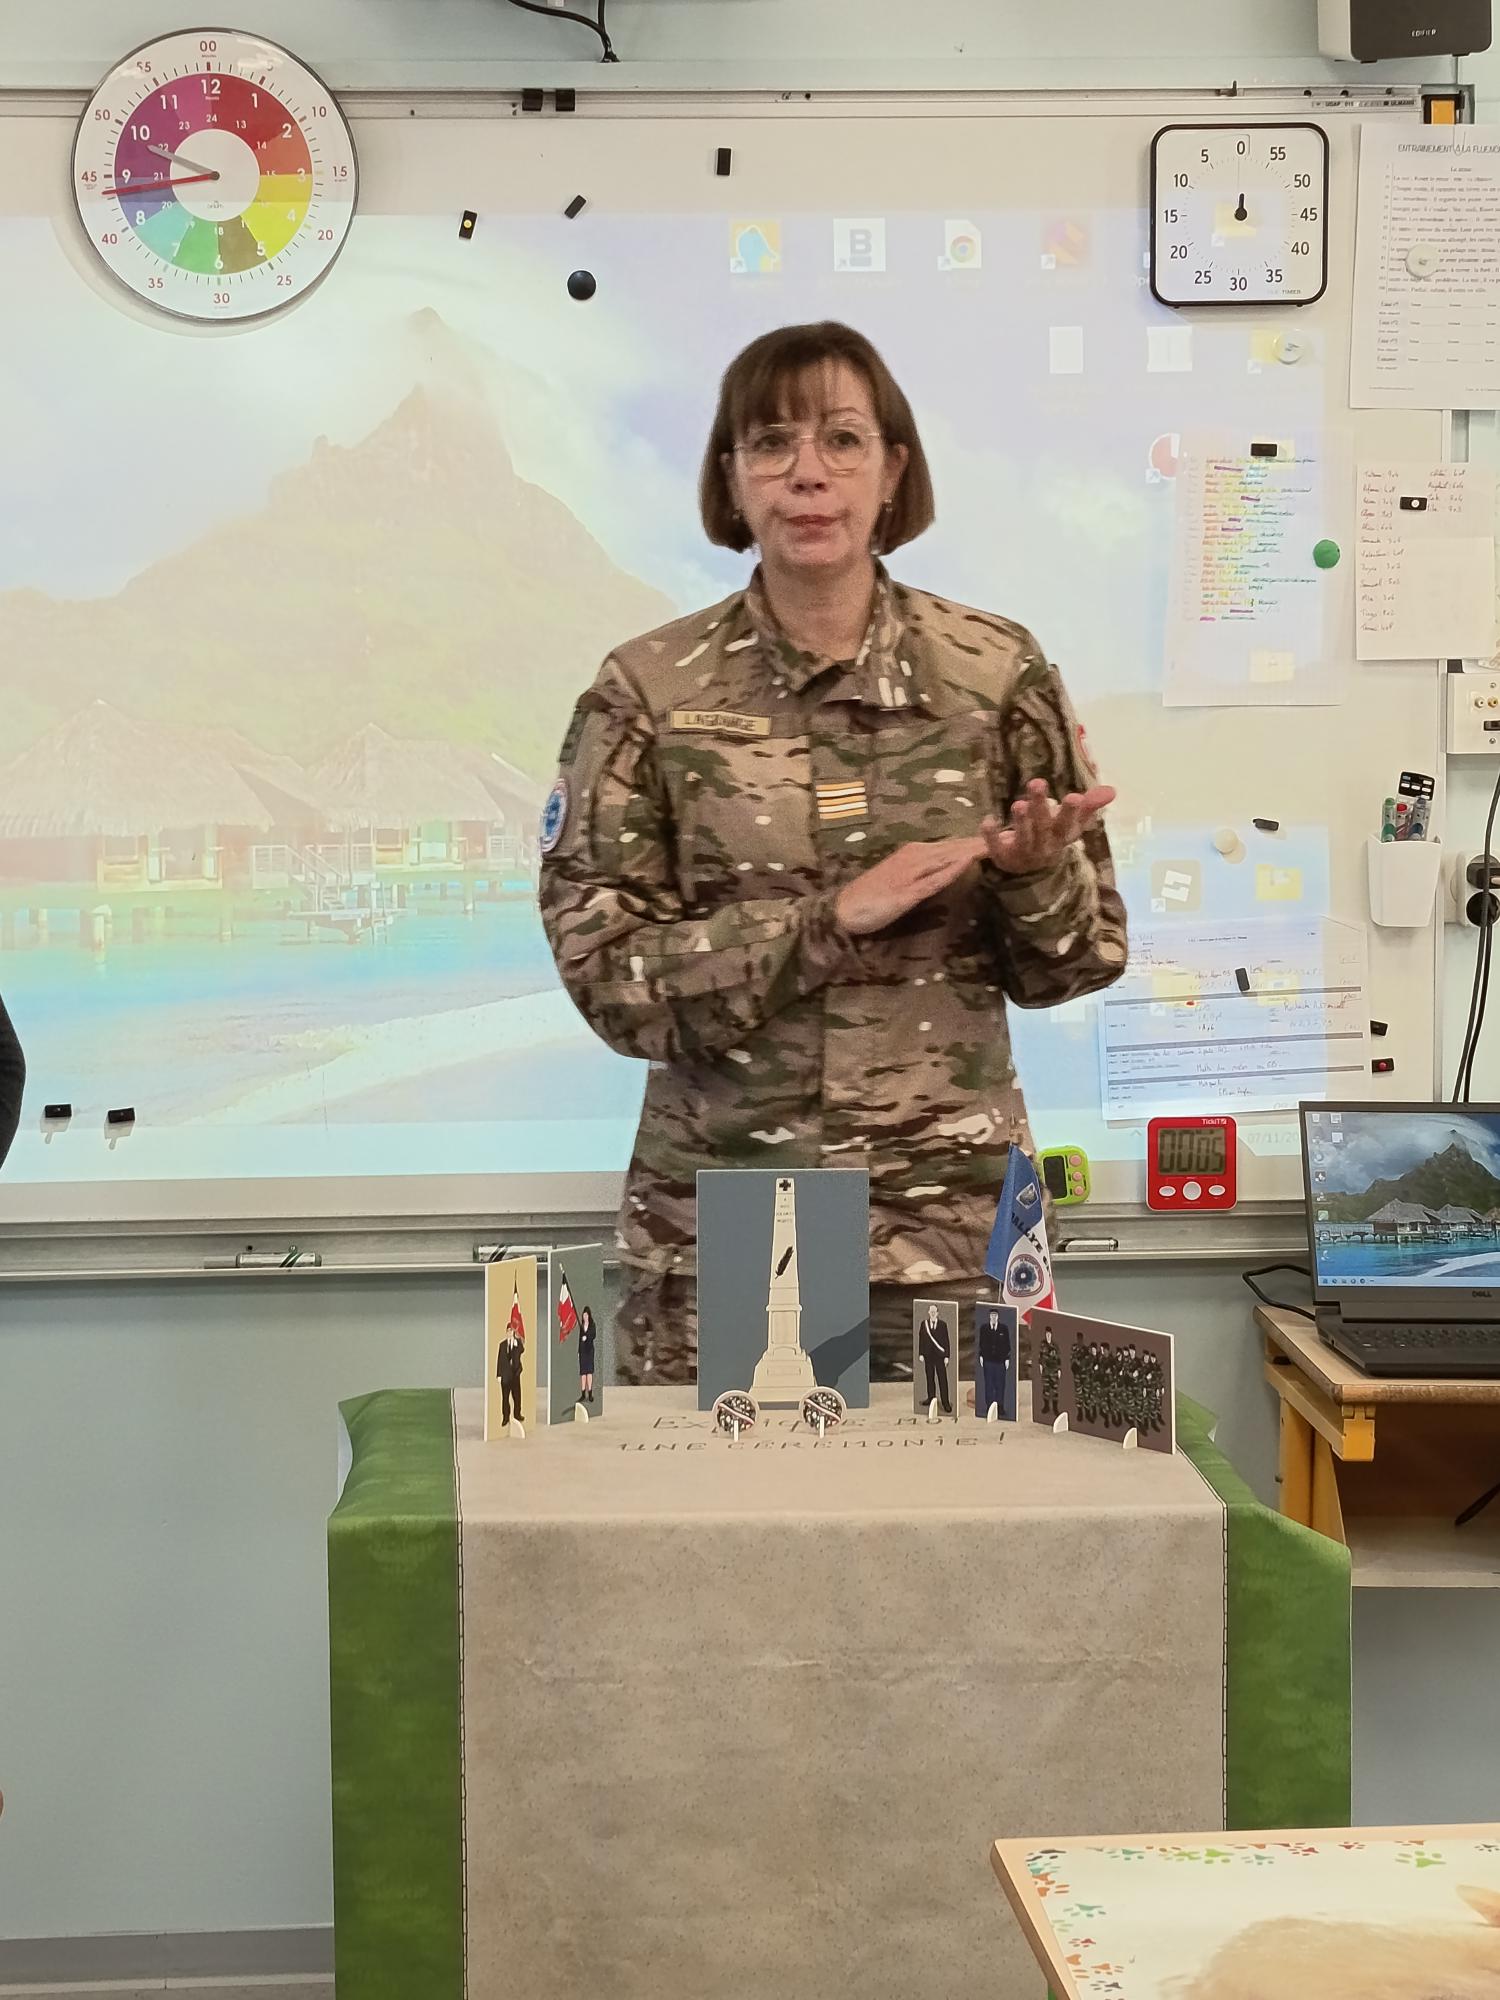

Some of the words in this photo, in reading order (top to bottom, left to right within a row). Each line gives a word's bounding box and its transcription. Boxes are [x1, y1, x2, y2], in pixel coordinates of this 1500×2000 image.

[200, 40, 217, 52] 00
[136, 61, 152, 72] 55
[201, 79, 221, 94] 12
[160, 94, 178, 110] 11
[251, 93, 258, 108] 1
[95, 109, 110, 121] 50
[206, 114, 218, 123] 24
[312, 106, 327, 118] 10
[178, 121, 190, 130] 23
[236, 120, 247, 129] 13
[282, 123, 292, 138] 2
[131, 125, 150, 141] 10
[256, 141, 267, 150] 14
[1237, 141, 1245, 155] 0
[1473, 145, 1500, 153] FLUENC
[1201, 149, 1209, 163] 5
[1270, 147, 1286, 161] 55
[81, 171, 97, 182] 45
[122, 169, 131, 184] 9
[153, 172, 164, 181] 21
[297, 168, 306, 182] 3
[333, 166, 347, 177] 15
[1174, 173, 1188, 188] 10
[1294, 174, 1311, 188] 50
[161, 201, 173, 209] 20
[136, 210, 145, 225] 8
[288, 208, 296, 222] 4
[1164, 209, 1178, 223] 15
[1300, 208, 1318, 221] 45
[101, 233, 118, 244] 40
[318, 229, 333, 240] 20
[171, 242, 180, 257] 7
[256, 242, 265, 257] 5
[1170, 245, 1187, 259] 20
[1291, 242, 1309, 255] 40
[214, 254, 223, 269] 6
[276, 275, 292, 286] 25
[1195, 271, 1212, 284] 25
[1266, 269, 1282, 283] 35
[148, 278, 164, 289] 35
[1230, 277, 1247, 291] 30
[213, 293, 230, 303] 30
[1472, 1290, 1492, 1298] DELL
